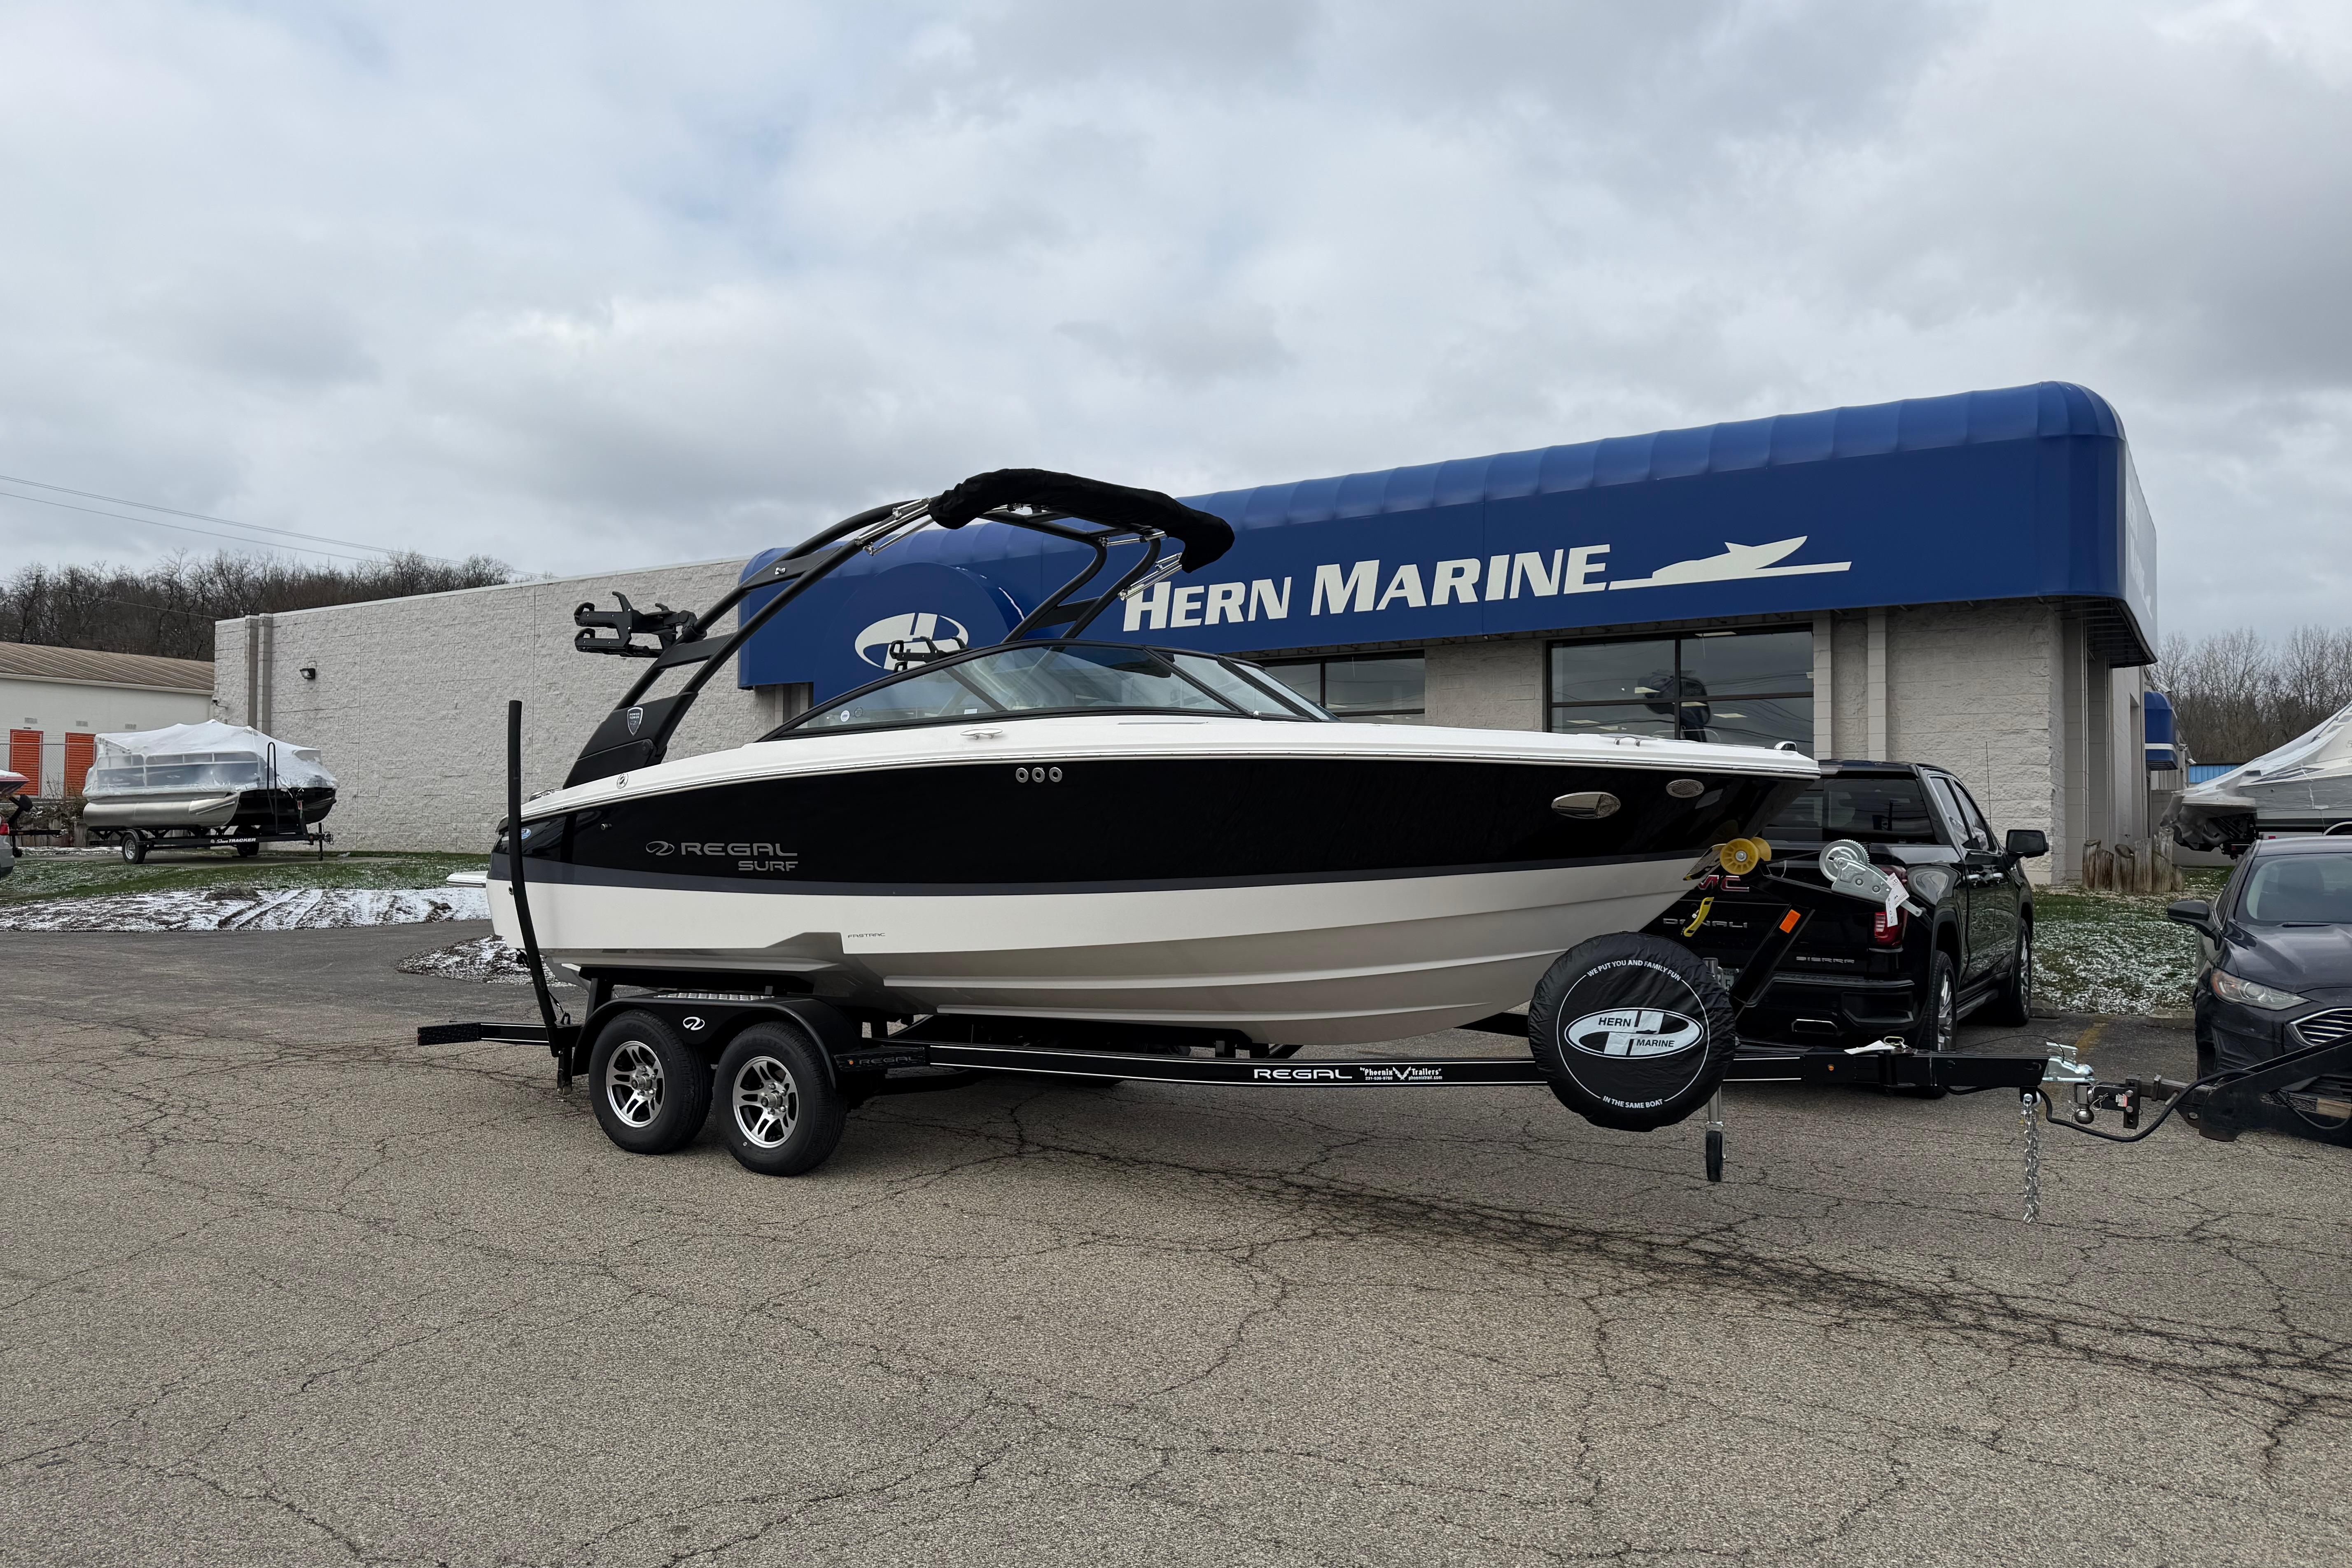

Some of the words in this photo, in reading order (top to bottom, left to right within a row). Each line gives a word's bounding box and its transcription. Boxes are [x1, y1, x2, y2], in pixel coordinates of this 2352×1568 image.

[1123, 576, 1291, 632] HERN
[1310, 544, 1610, 616] MARINE
[681, 842, 798, 856] REGAL
[738, 861, 798, 872] SURF
[1697, 875, 1750, 892] MC
[1587, 968, 1598, 977] WE
[1598, 962, 1611, 972] PUT
[1644, 961, 1668, 973] FAMILY
[1667, 969, 1682, 981] FUN
[1598, 1017, 1631, 1027] HERN
[1636, 1039, 1675, 1047] MARINE
[859, 1056, 919, 1065] REGAL
[1254, 1069, 1352, 1079] REGAL
[1611, 1099, 1624, 1107] THE
[1645, 1099, 1663, 1108] BOAT
